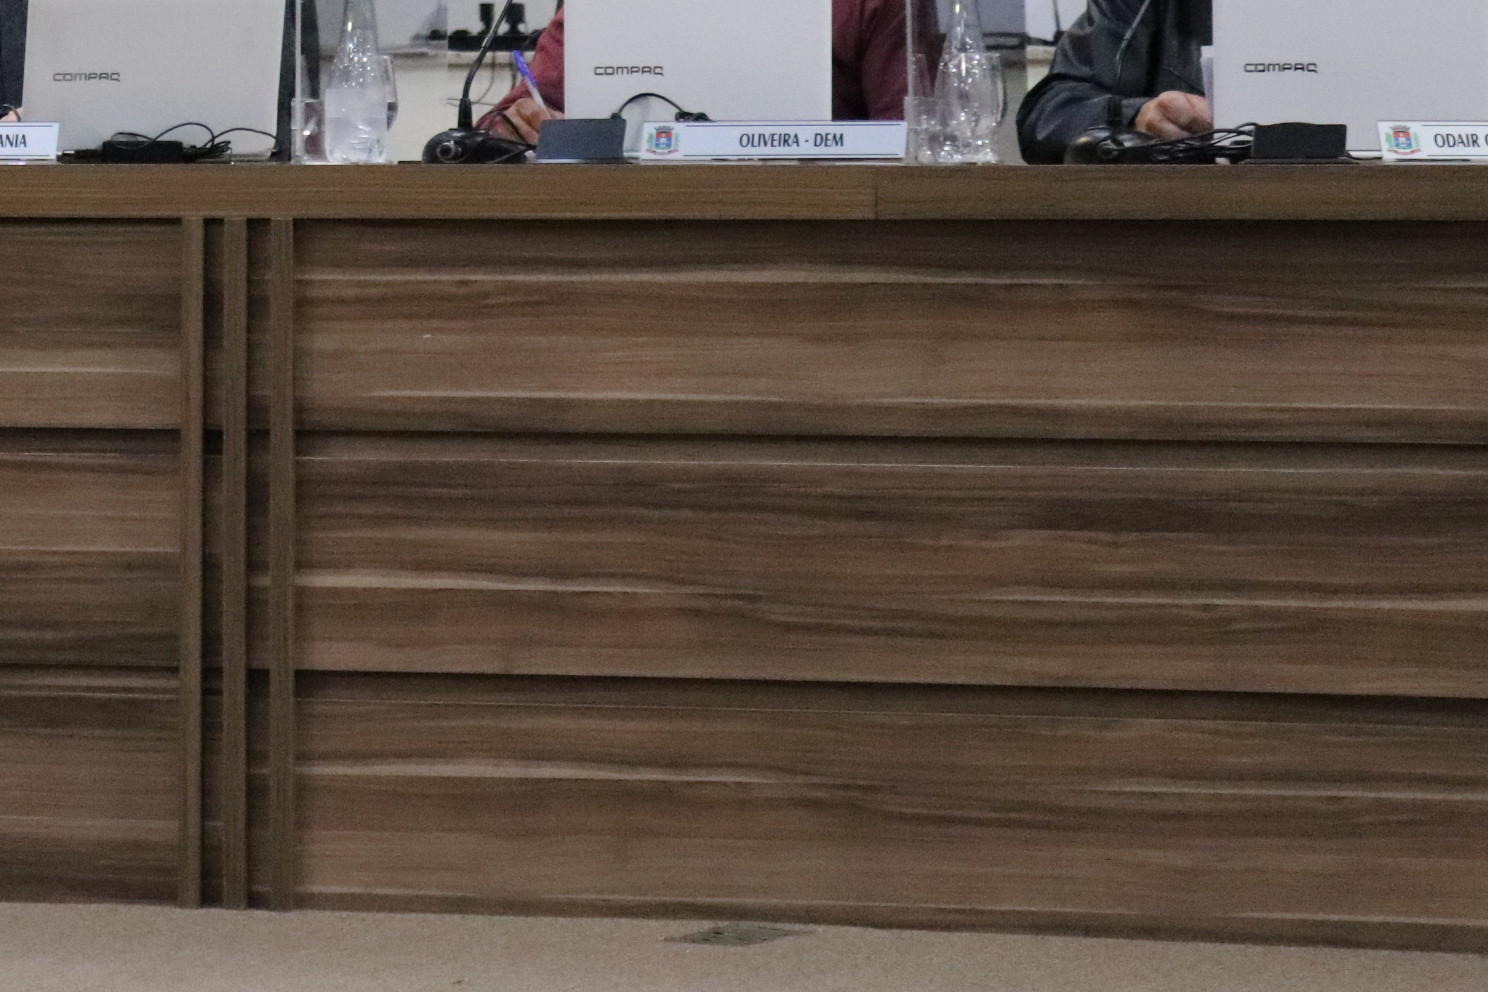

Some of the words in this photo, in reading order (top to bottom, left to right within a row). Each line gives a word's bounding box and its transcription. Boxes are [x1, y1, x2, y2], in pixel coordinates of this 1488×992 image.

[594, 66, 664, 77] COMPAQ
[1243, 63, 1318, 74] COMPAQ
[53, 72, 121, 83] COMPAQ
[739, 133, 799, 147] OLIVEIRA
[814, 133, 844, 147] DEM
[1434, 133, 1480, 148] ODAIR
